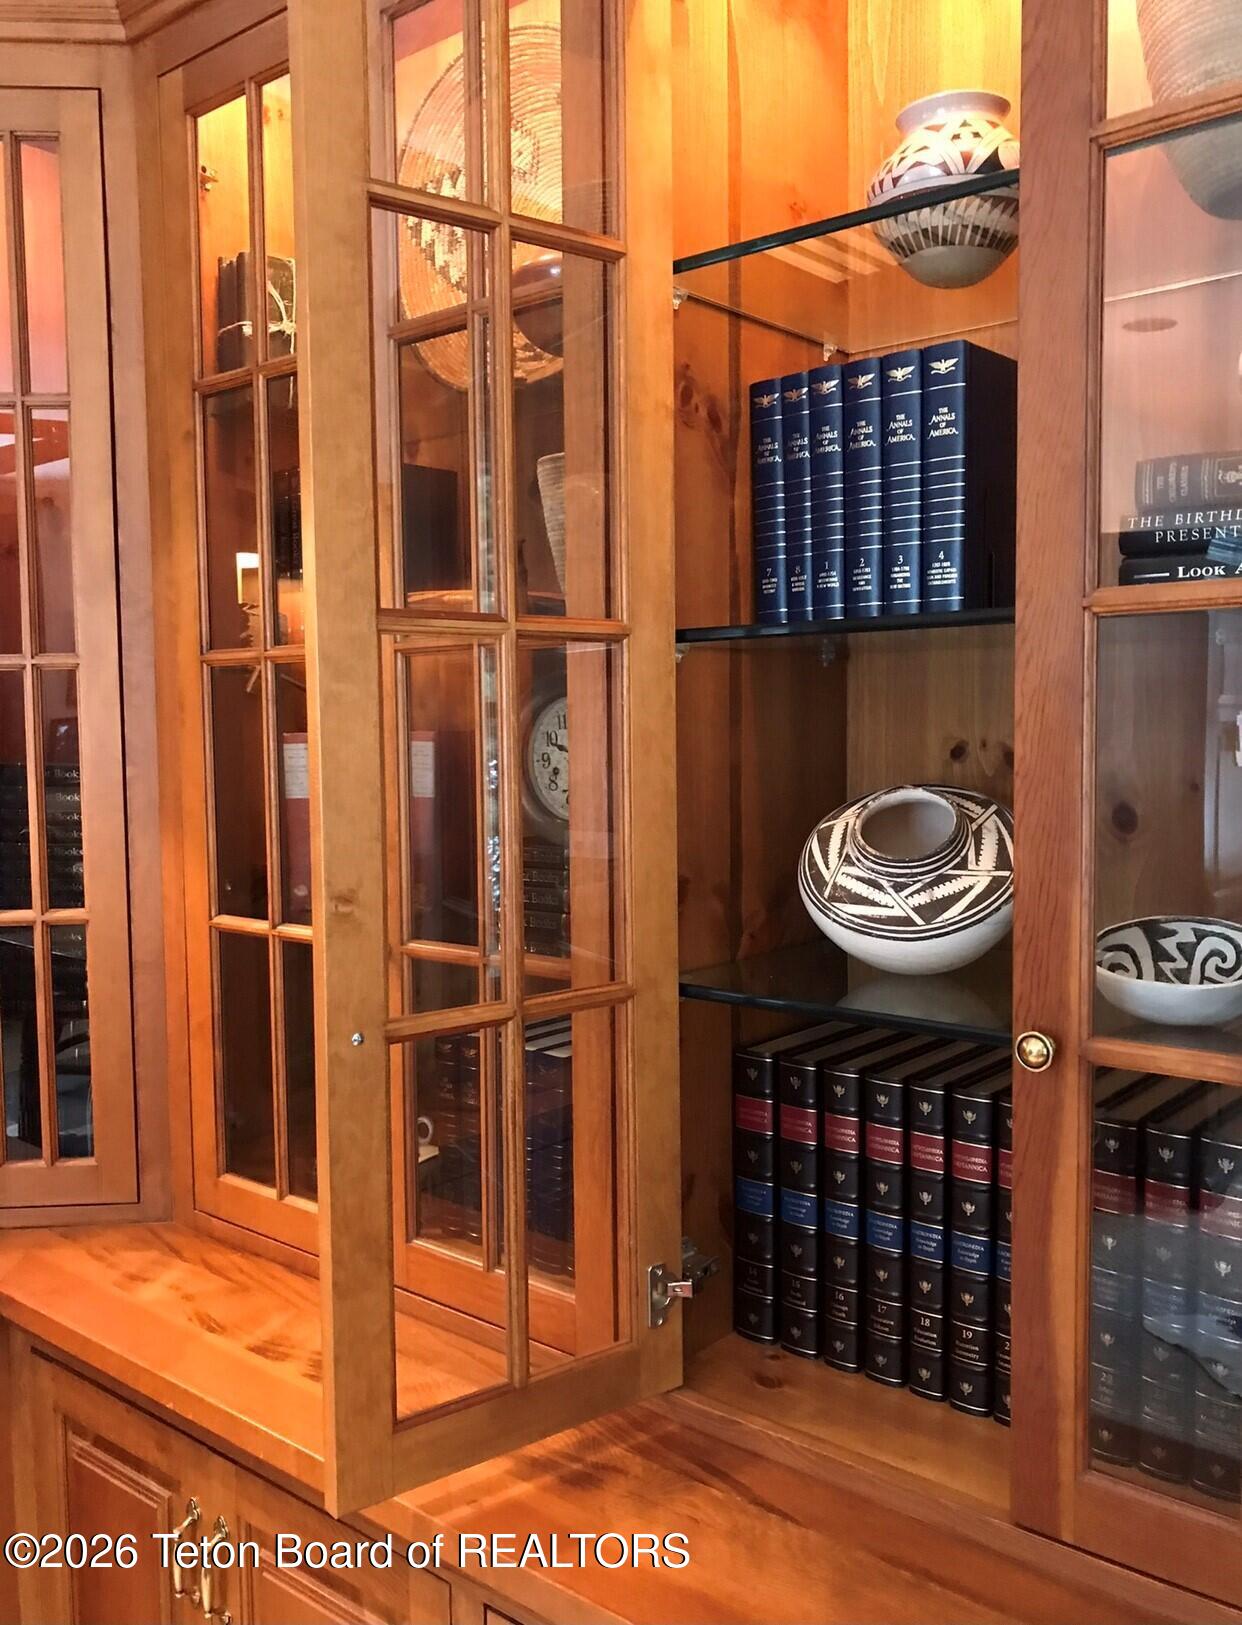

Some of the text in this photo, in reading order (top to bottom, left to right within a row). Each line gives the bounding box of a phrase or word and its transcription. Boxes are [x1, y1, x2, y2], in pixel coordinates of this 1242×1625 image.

[928, 412, 956, 426] ANNALS
[886, 419, 913, 432] ANNALS
[927, 427, 959, 439] AMERICA
[884, 434, 916, 446] AMERICA
[1128, 515, 1165, 529] THE
[1155, 524, 1241, 543] PRESENT
[897, 554, 904, 564] 3
[938, 550, 945, 560] 4
[824, 561, 830, 570] 1
[860, 558, 866, 566] 2
[766, 568, 772, 577] 7
[546, 730, 558, 748] 10
[542, 752, 552, 770] 9
[548, 774, 558, 792] 8
[835, 1290, 845, 1301] 16
[877, 1304, 887, 1314] 17
[920, 1316, 930, 1327] 18
[962, 1329, 973, 1339] 19
